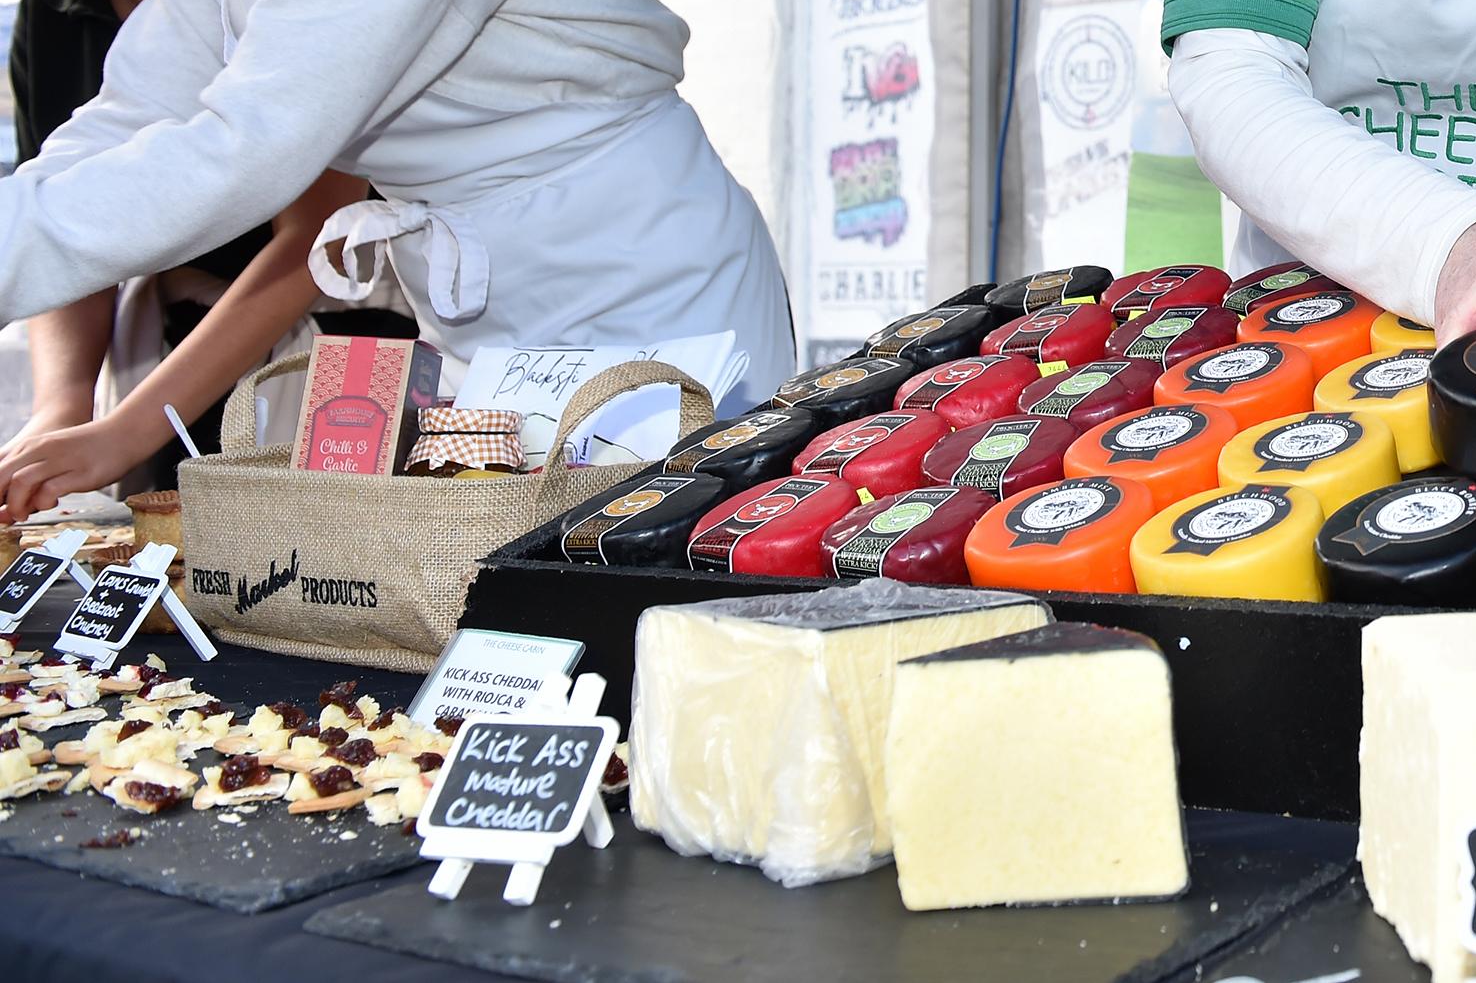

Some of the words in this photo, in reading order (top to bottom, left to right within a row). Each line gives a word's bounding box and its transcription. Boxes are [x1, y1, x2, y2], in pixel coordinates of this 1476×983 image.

[493, 353, 587, 401] Blacksti
[1133, 411, 1171, 423] AMBER
[1285, 418, 1355, 430] BEECHWOOD
[320, 438, 353, 455] Chilli
[1042, 482, 1084, 496] AMBER
[1089, 483, 1113, 492] MIST
[1415, 486, 1456, 494] BLACK
[1217, 492, 1286, 507] BEECHWOOD
[838, 558, 859, 567] EXTRA
[192, 568, 232, 596] FRESH
[301, 576, 377, 608] PRODUCTS
[80, 596, 123, 619] Beetroot
[483, 638, 496, 648] THE
[498, 640, 521, 652] CHEESE
[522, 642, 546, 654] CABIN
[443, 667, 467, 681] KICK
[469, 671, 491, 684] ASS
[442, 686, 472, 701] WITH
[472, 690, 512, 707] RIOJCA
[514, 697, 526, 709] &
[461, 729, 527, 764] Kick
[446, 798, 569, 830] Cheddar
